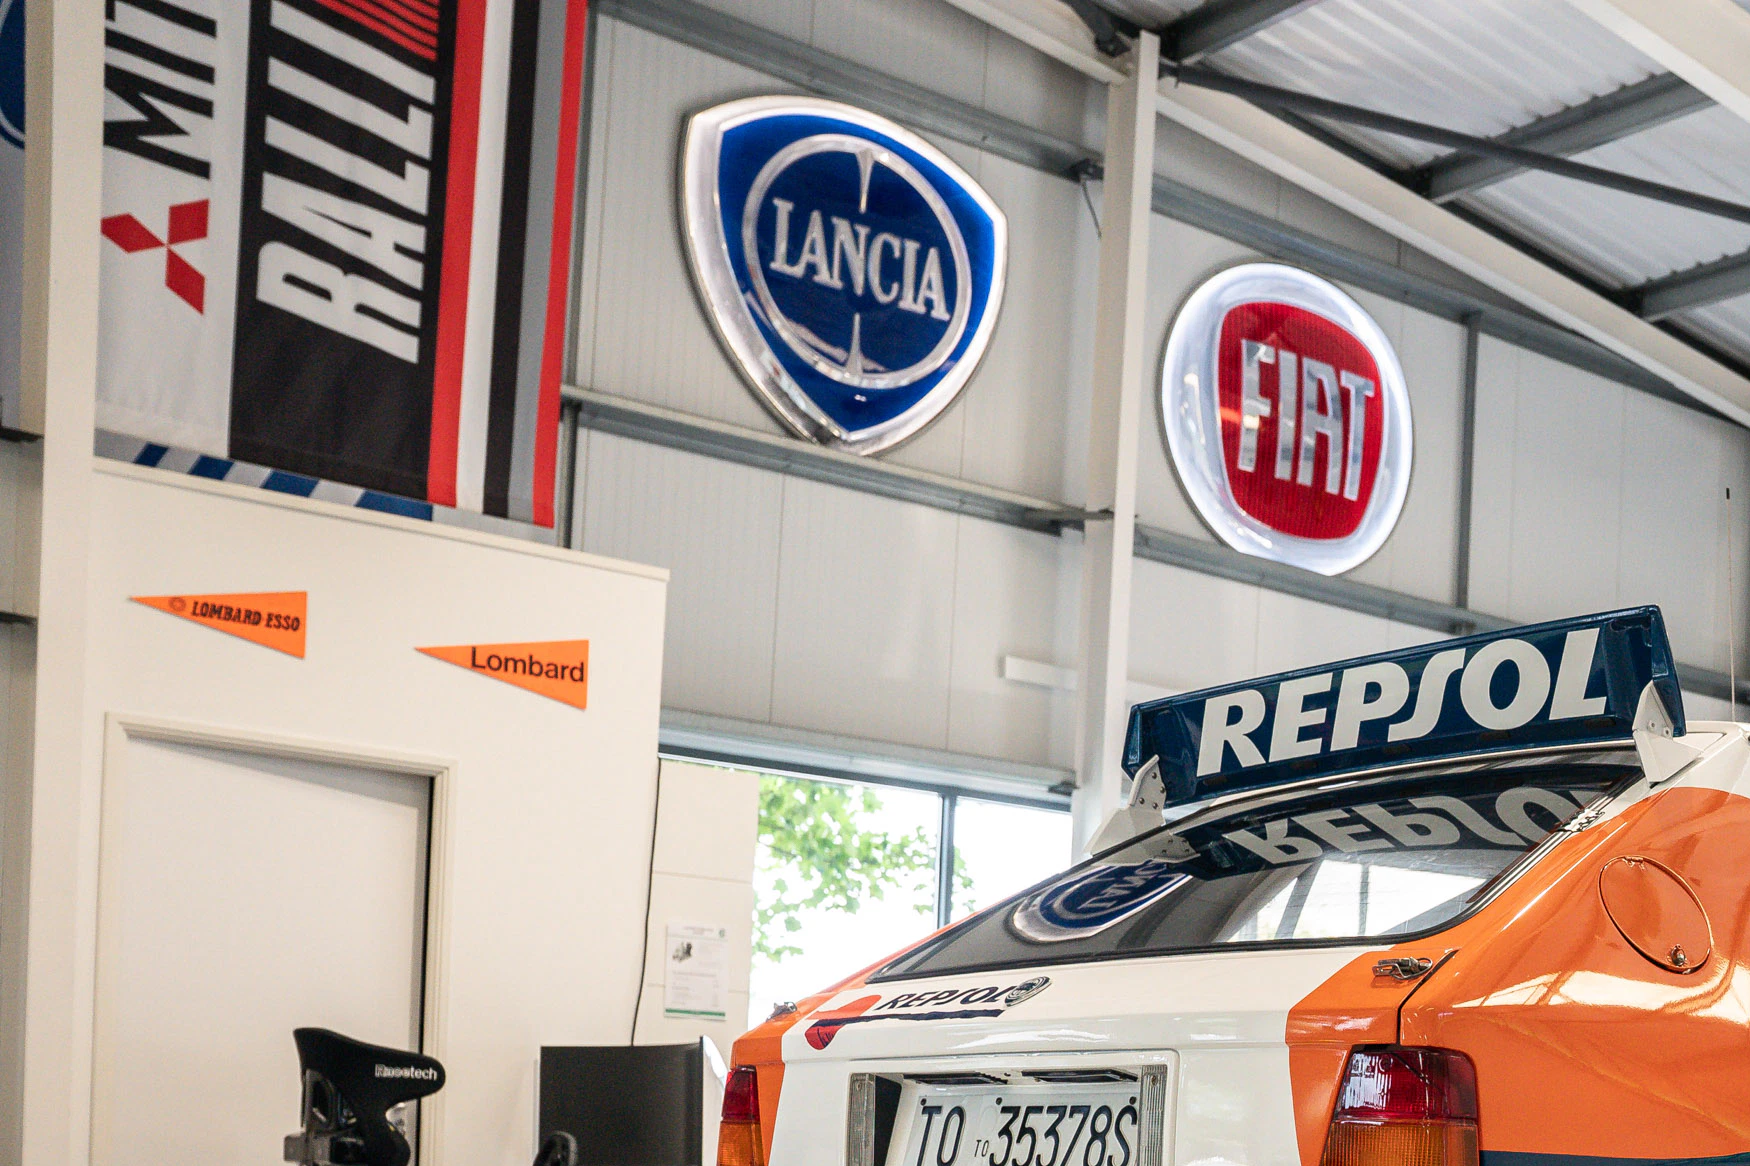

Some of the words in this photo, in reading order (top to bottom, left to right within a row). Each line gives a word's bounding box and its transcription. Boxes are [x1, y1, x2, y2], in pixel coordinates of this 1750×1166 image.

[770, 198, 950, 321] LANCIA
[1239, 338, 1376, 501] FIAT
[191, 601, 262, 626] LOMBARD
[265, 613, 301, 632] ESSO
[471, 646, 584, 682] Lombard
[1197, 627, 1608, 778] REPSOL
[874, 985, 1017, 1011] REPSOL
[974, 1139, 990, 1158] TO
